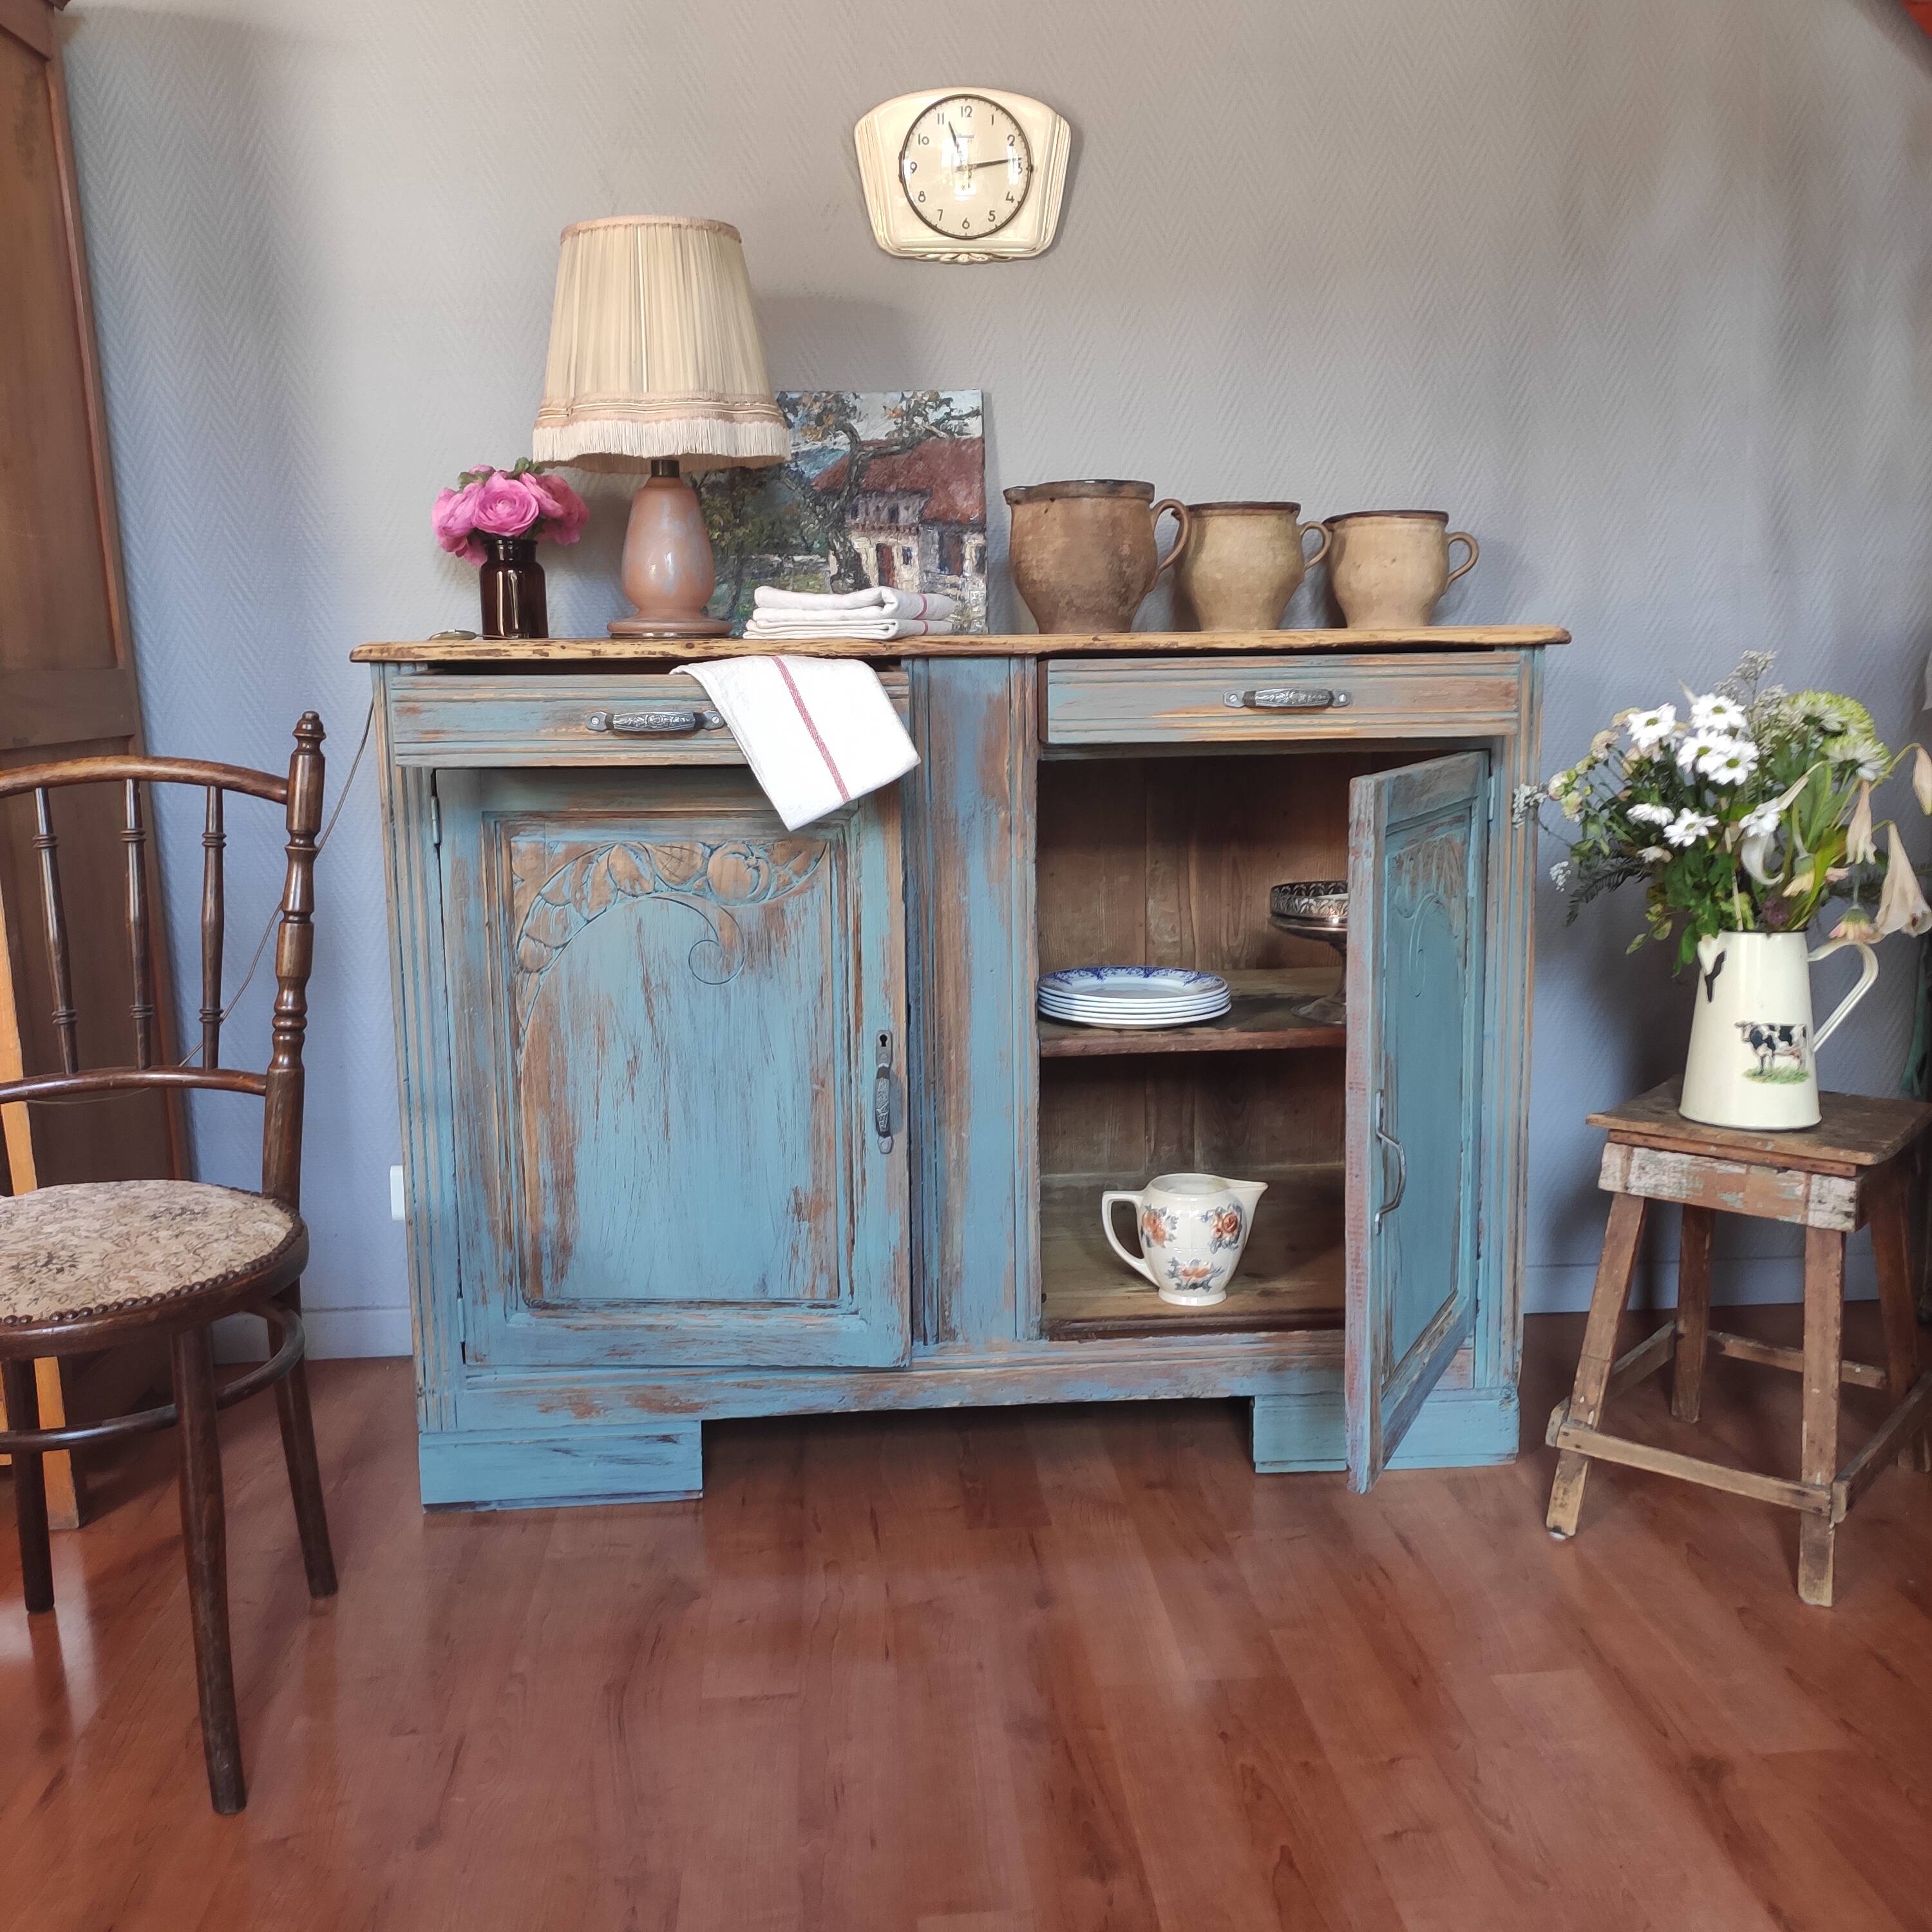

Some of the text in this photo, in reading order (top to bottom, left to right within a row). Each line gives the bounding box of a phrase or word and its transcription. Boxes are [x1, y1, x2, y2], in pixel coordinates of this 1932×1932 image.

[961, 106, 972, 117] 12
[937, 113, 944, 125] 11
[991, 115, 994, 126] 1
[918, 134, 929, 145] 10
[1007, 135, 1015, 146] 2
[910, 162, 917, 173] 9
[918, 191, 925, 202] 8
[1006, 191, 1014, 203] 4
[937, 210, 943, 221] 7
[988, 211, 995, 222] 5
[962, 218, 970, 229] 6
